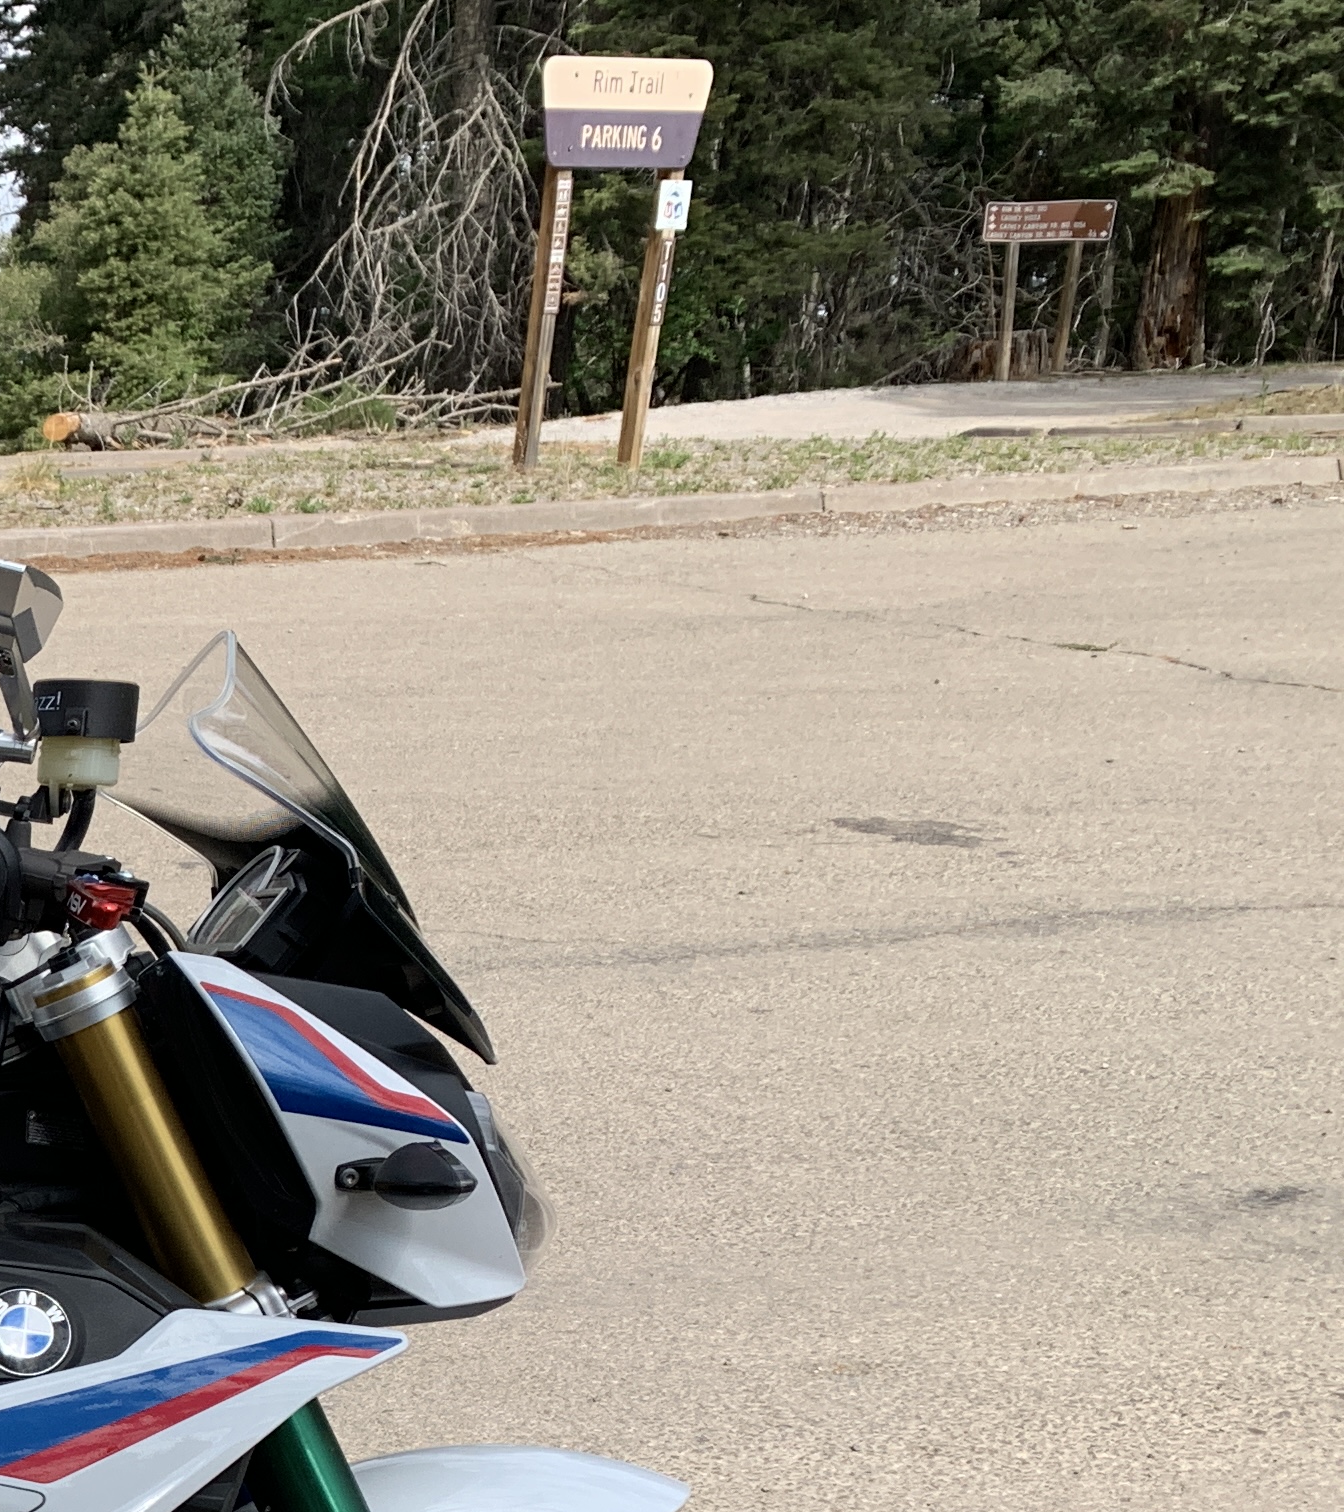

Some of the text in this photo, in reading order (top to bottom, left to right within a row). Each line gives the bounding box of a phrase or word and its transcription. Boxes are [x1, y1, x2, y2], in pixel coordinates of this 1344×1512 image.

[593, 69, 665, 95] Rim Trail
[581, 124, 663, 152] PARKING 6
